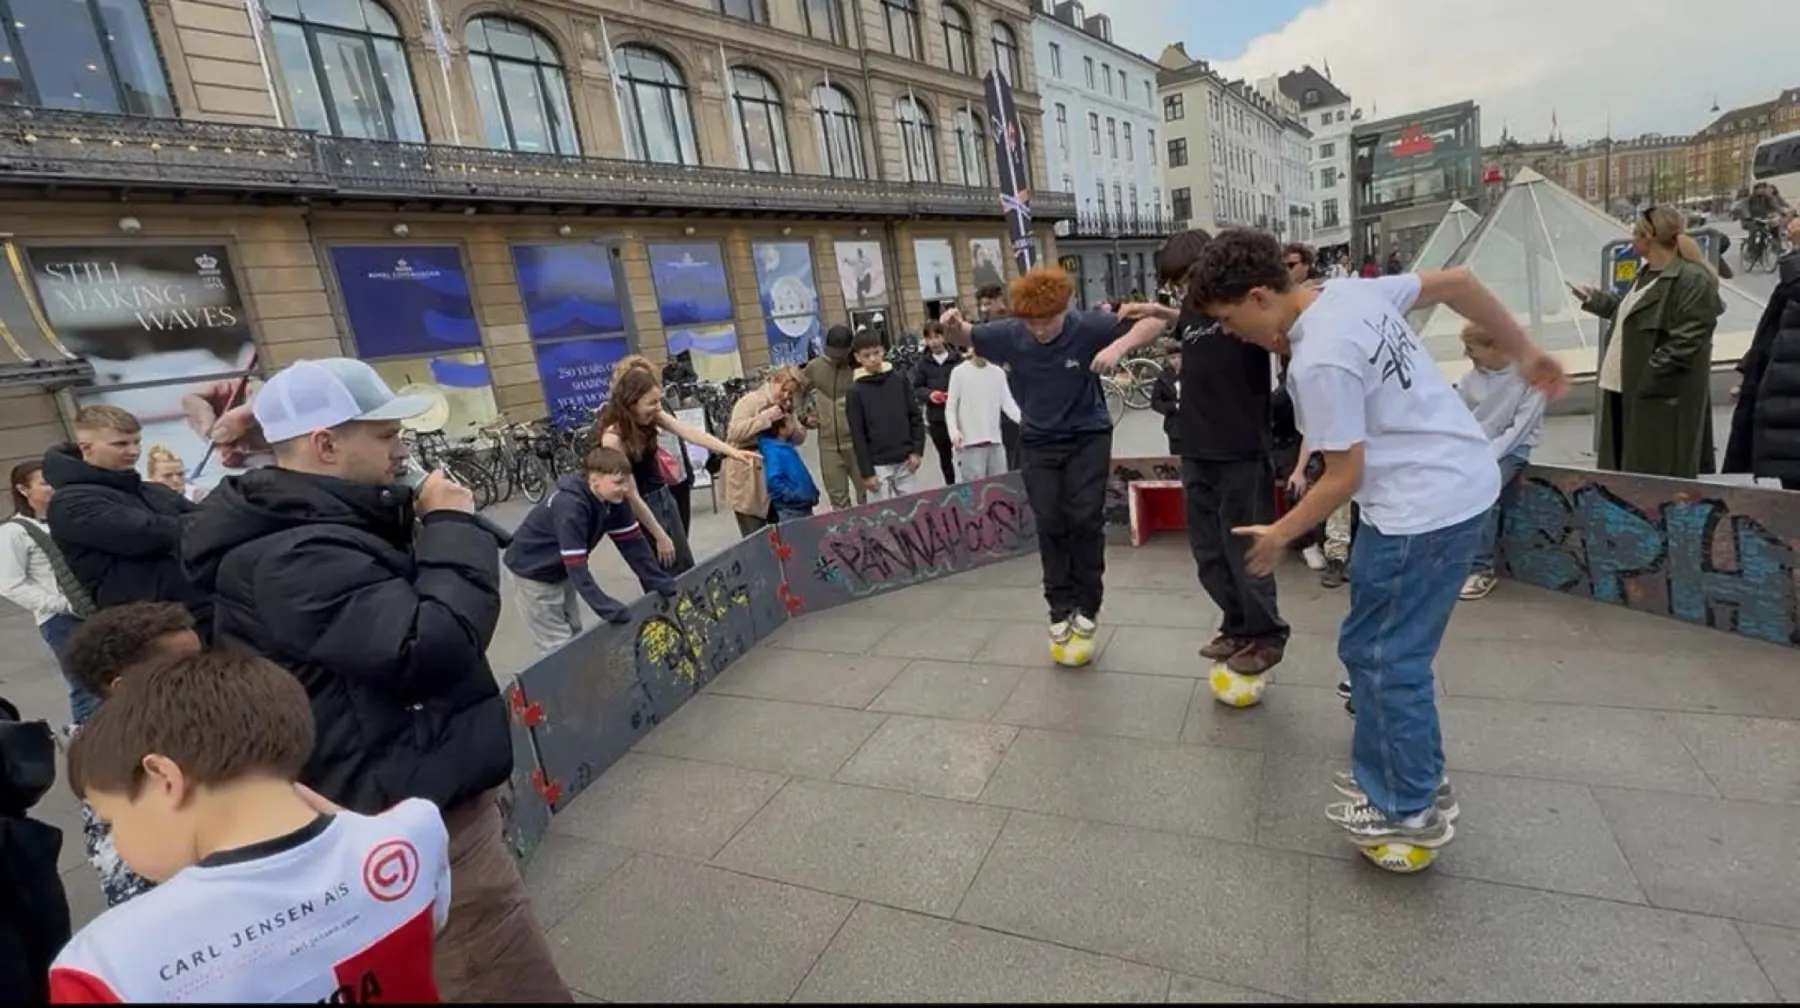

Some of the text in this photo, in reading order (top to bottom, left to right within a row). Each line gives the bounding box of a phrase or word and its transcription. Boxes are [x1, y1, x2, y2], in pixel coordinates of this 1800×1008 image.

[44, 261, 121, 285] STILL
[54, 285, 187, 313] MAKING
[134, 306, 238, 331] WAVES
[159, 944, 221, 981] CARL
[231, 900, 314, 949] JENSEN
